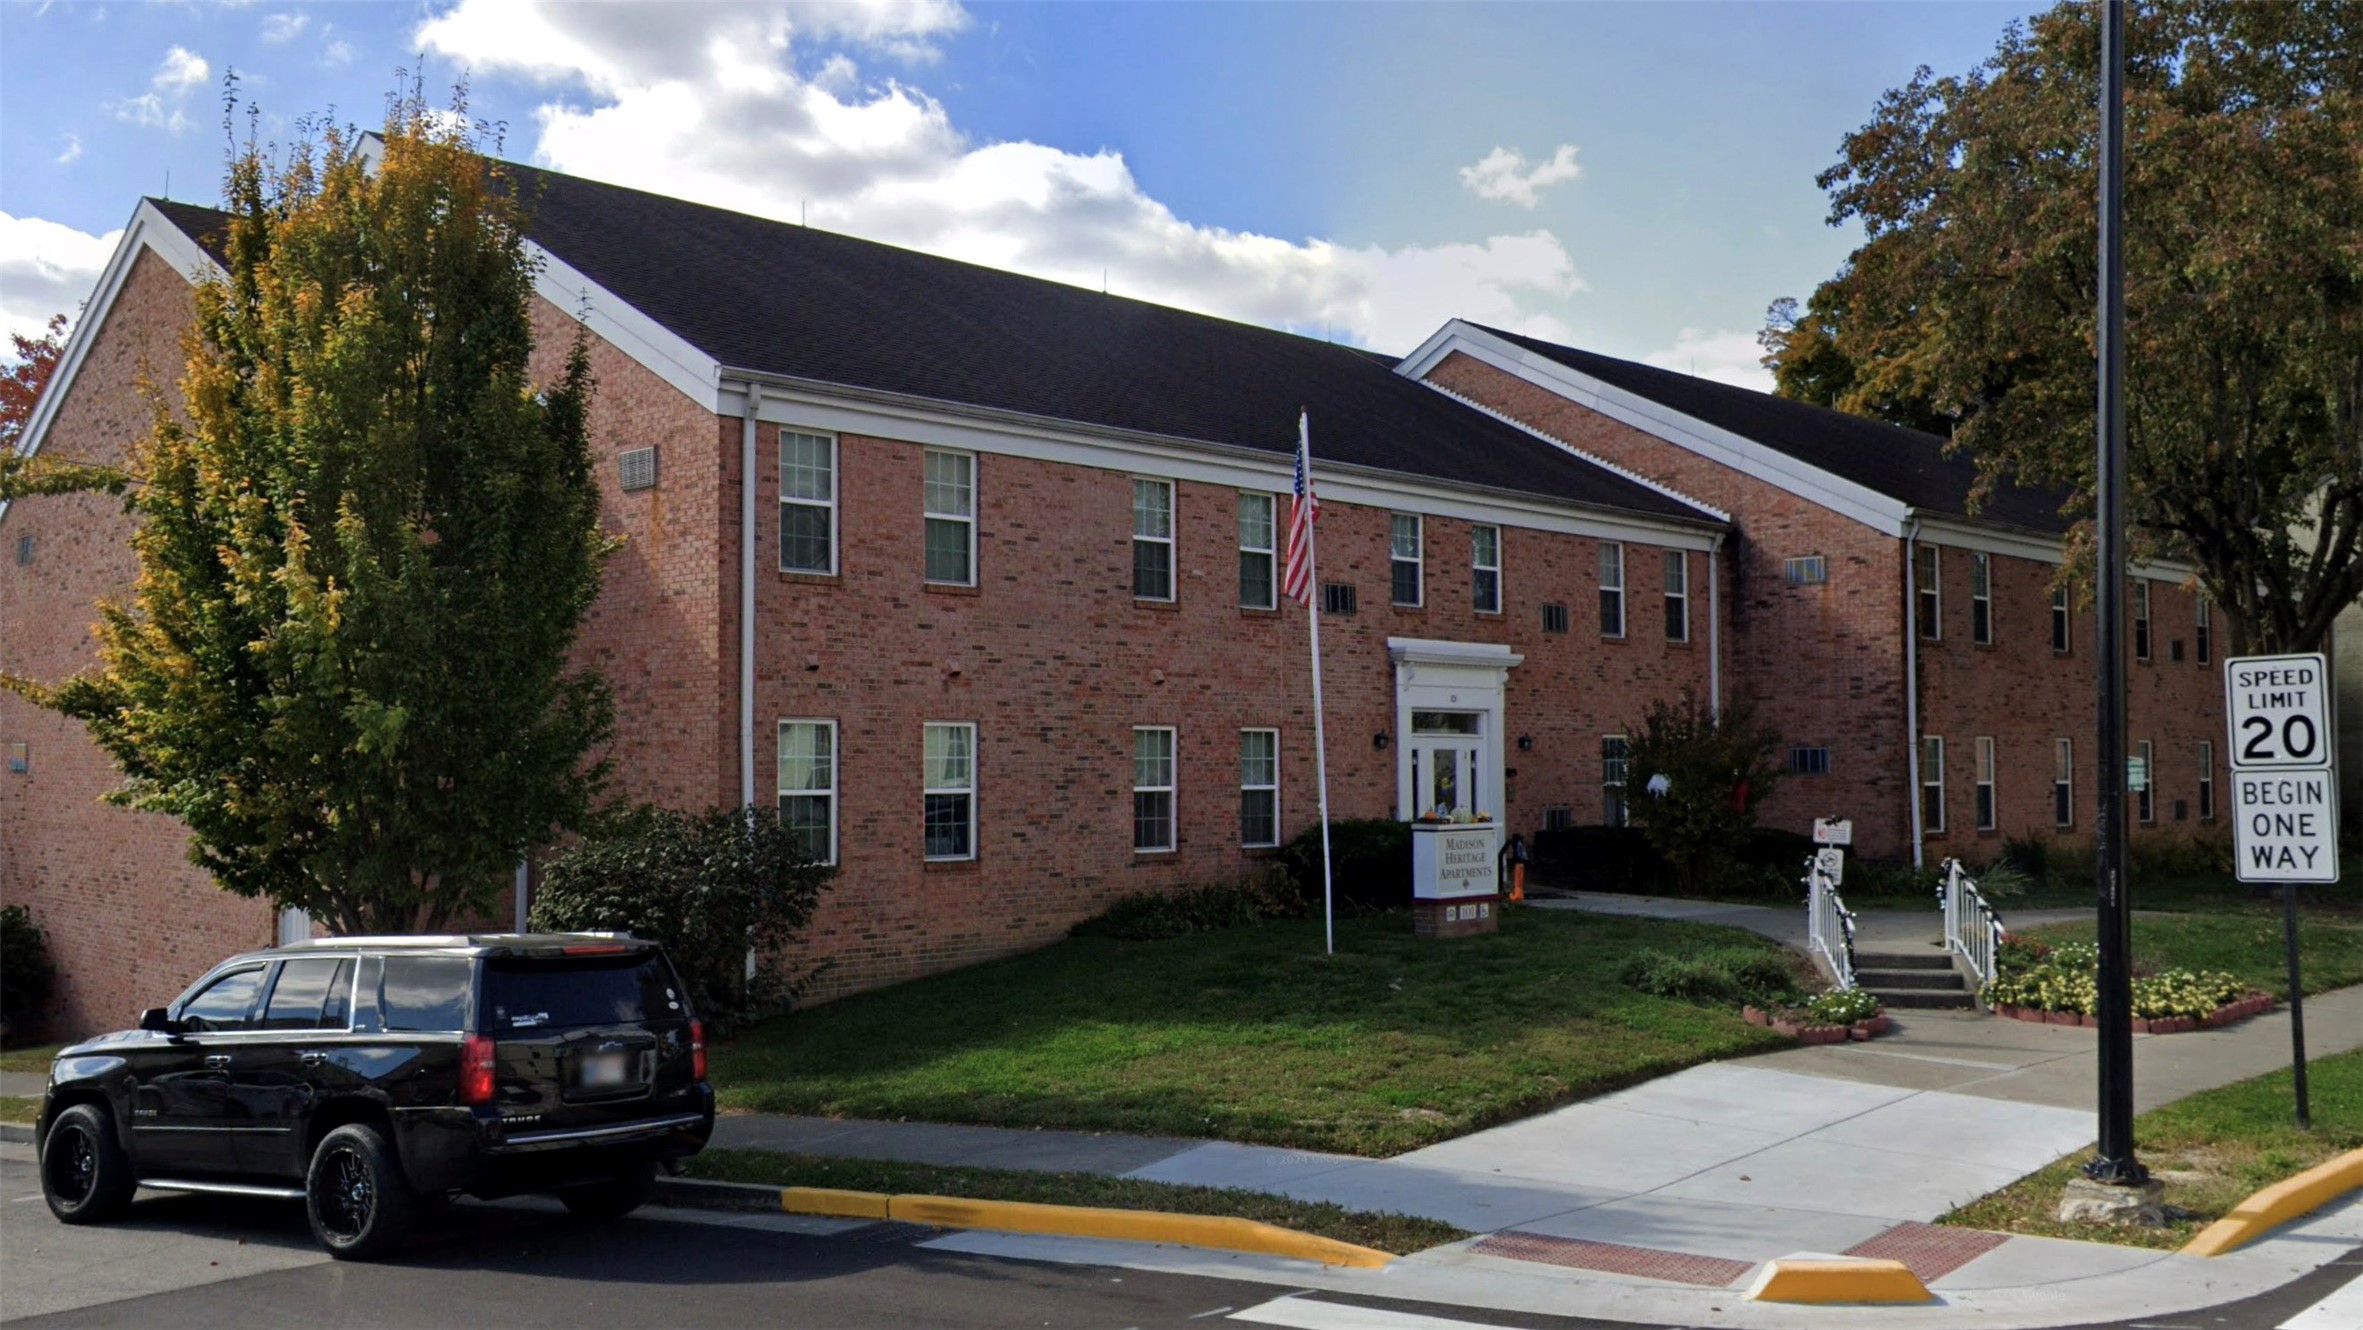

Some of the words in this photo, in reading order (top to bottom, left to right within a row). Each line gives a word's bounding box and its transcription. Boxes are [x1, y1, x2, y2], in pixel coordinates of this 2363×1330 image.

[2238, 668, 2313, 688] SPEED
[2248, 691, 2307, 709] LIMIT
[2241, 714, 2316, 759] 20
[2243, 781, 2322, 805] BEGIN
[2252, 813, 2316, 837] ONE
[1446, 838, 1485, 851] MADISON
[1445, 852, 1486, 865] HERITAGE
[2251, 845, 2319, 869] WAY
[1439, 866, 1492, 880] APARTMENTS
